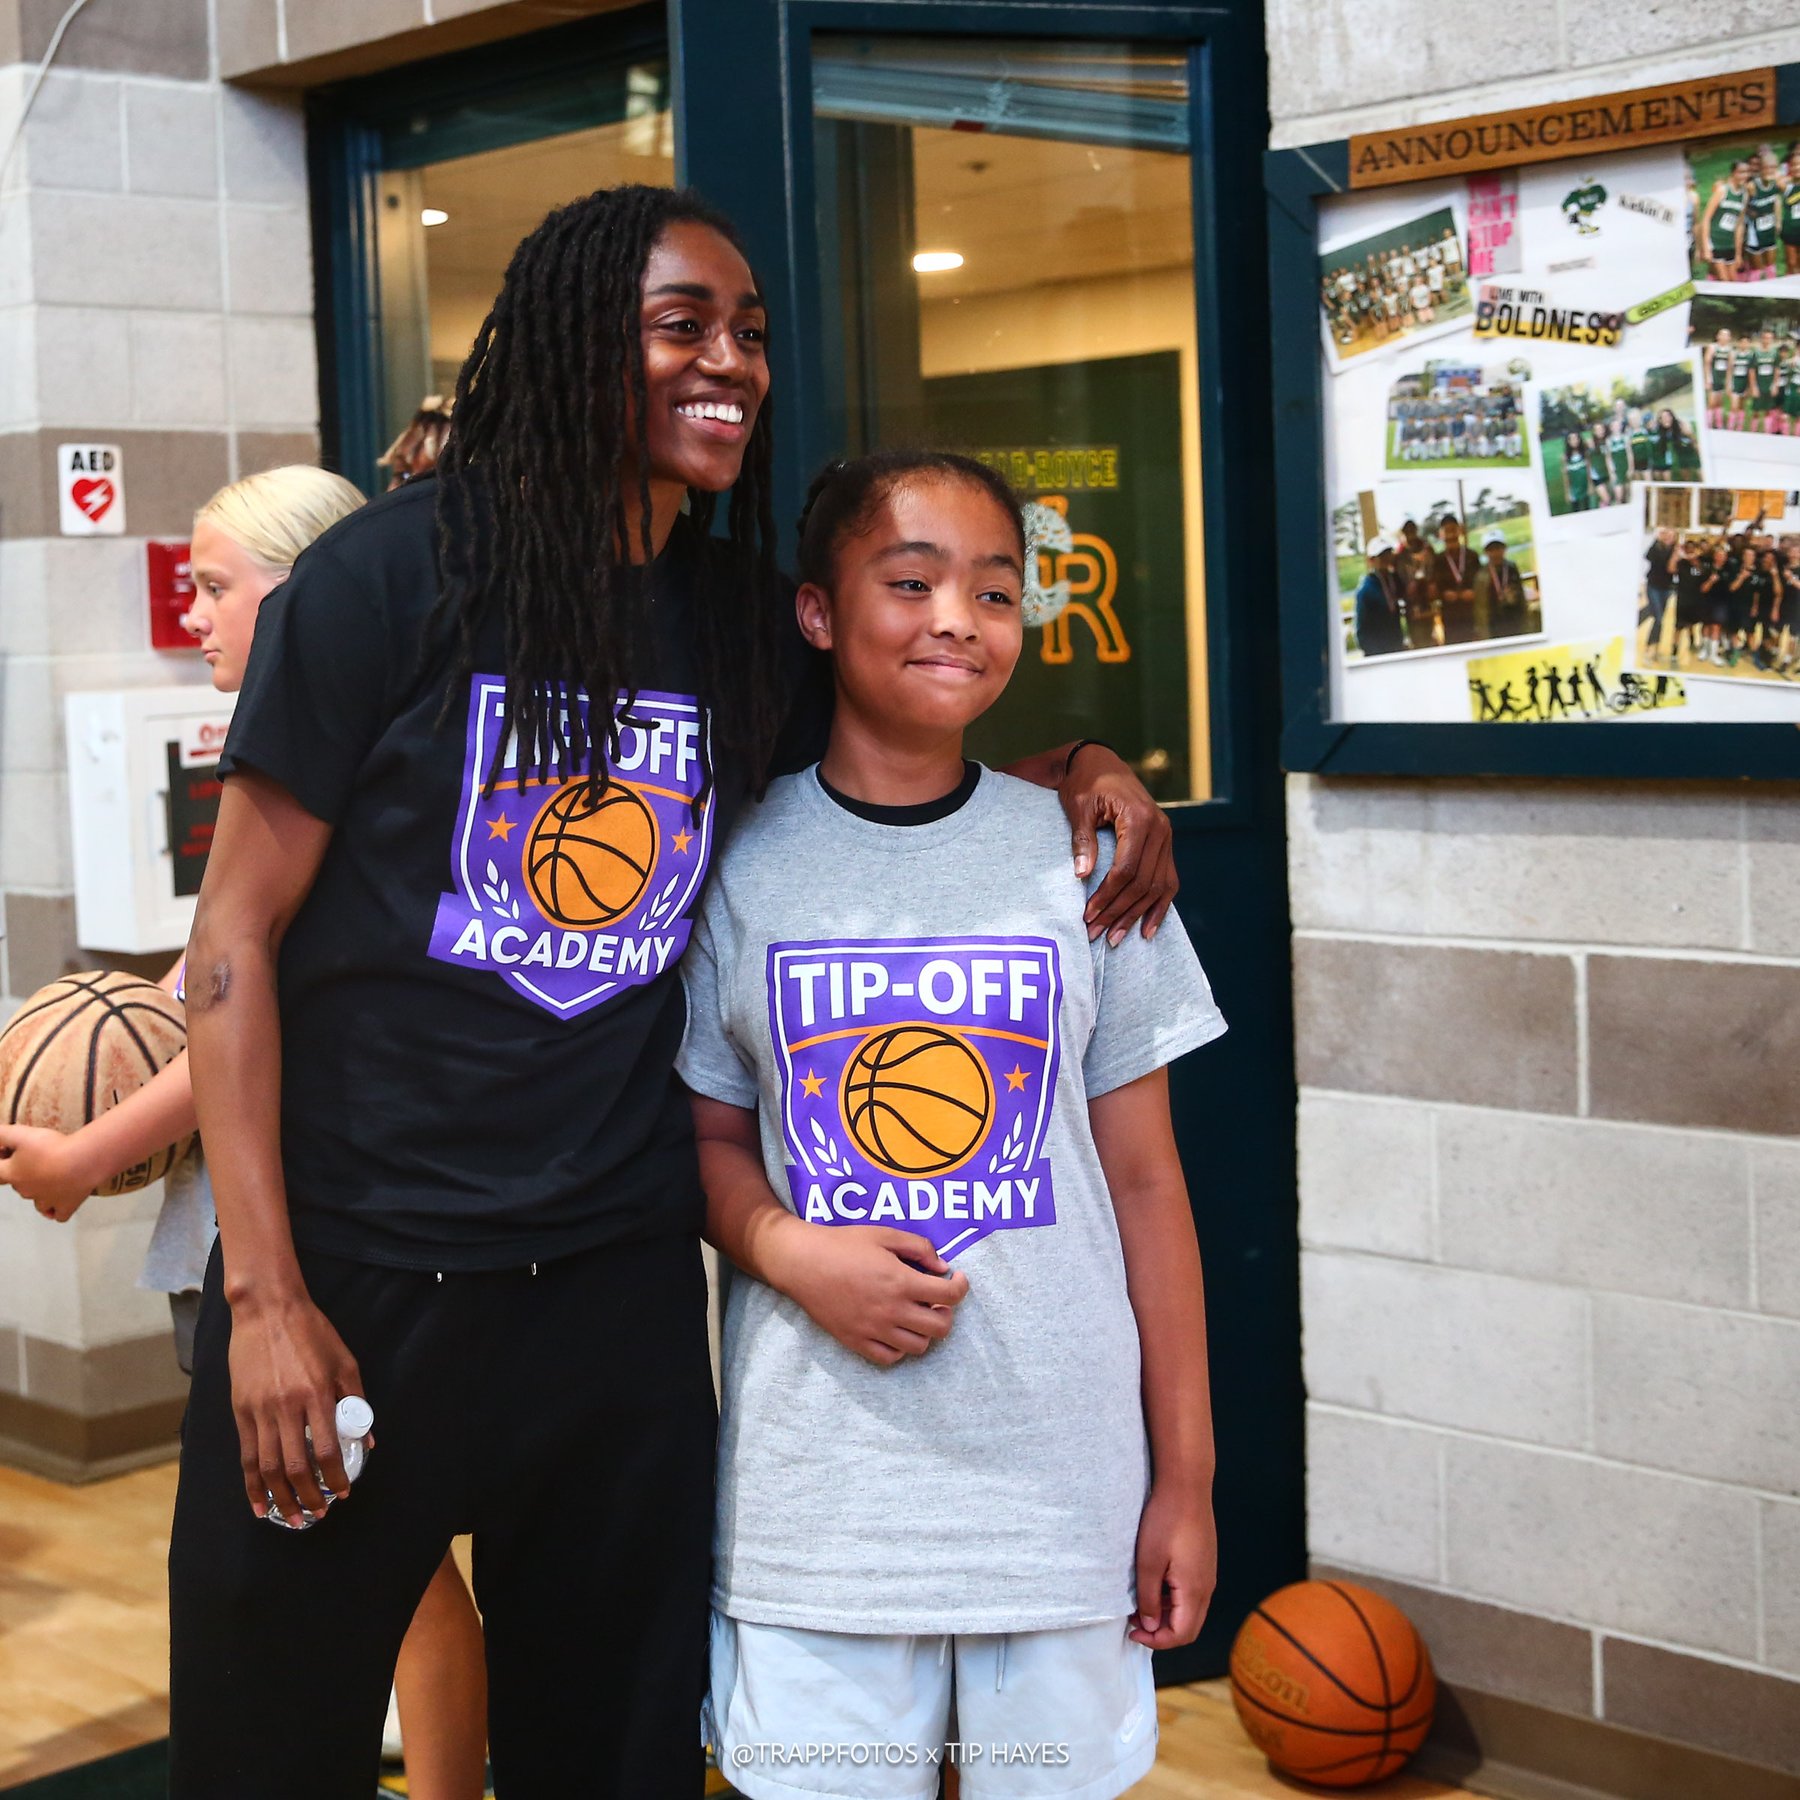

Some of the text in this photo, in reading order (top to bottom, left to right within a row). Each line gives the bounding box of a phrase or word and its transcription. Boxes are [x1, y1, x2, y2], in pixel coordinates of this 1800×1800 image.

[1356, 81, 1767, 174] ANNOUNCEMENTS
[1518, 288, 1544, 303] WITH
[1476, 301, 1619, 345] BOLDNESS
[71, 450, 114, 471] AED
[451, 918, 676, 976] ACADEMY
[788, 959, 1041, 1027] TIP-OFF
[805, 1177, 1040, 1223] ACADEMY
